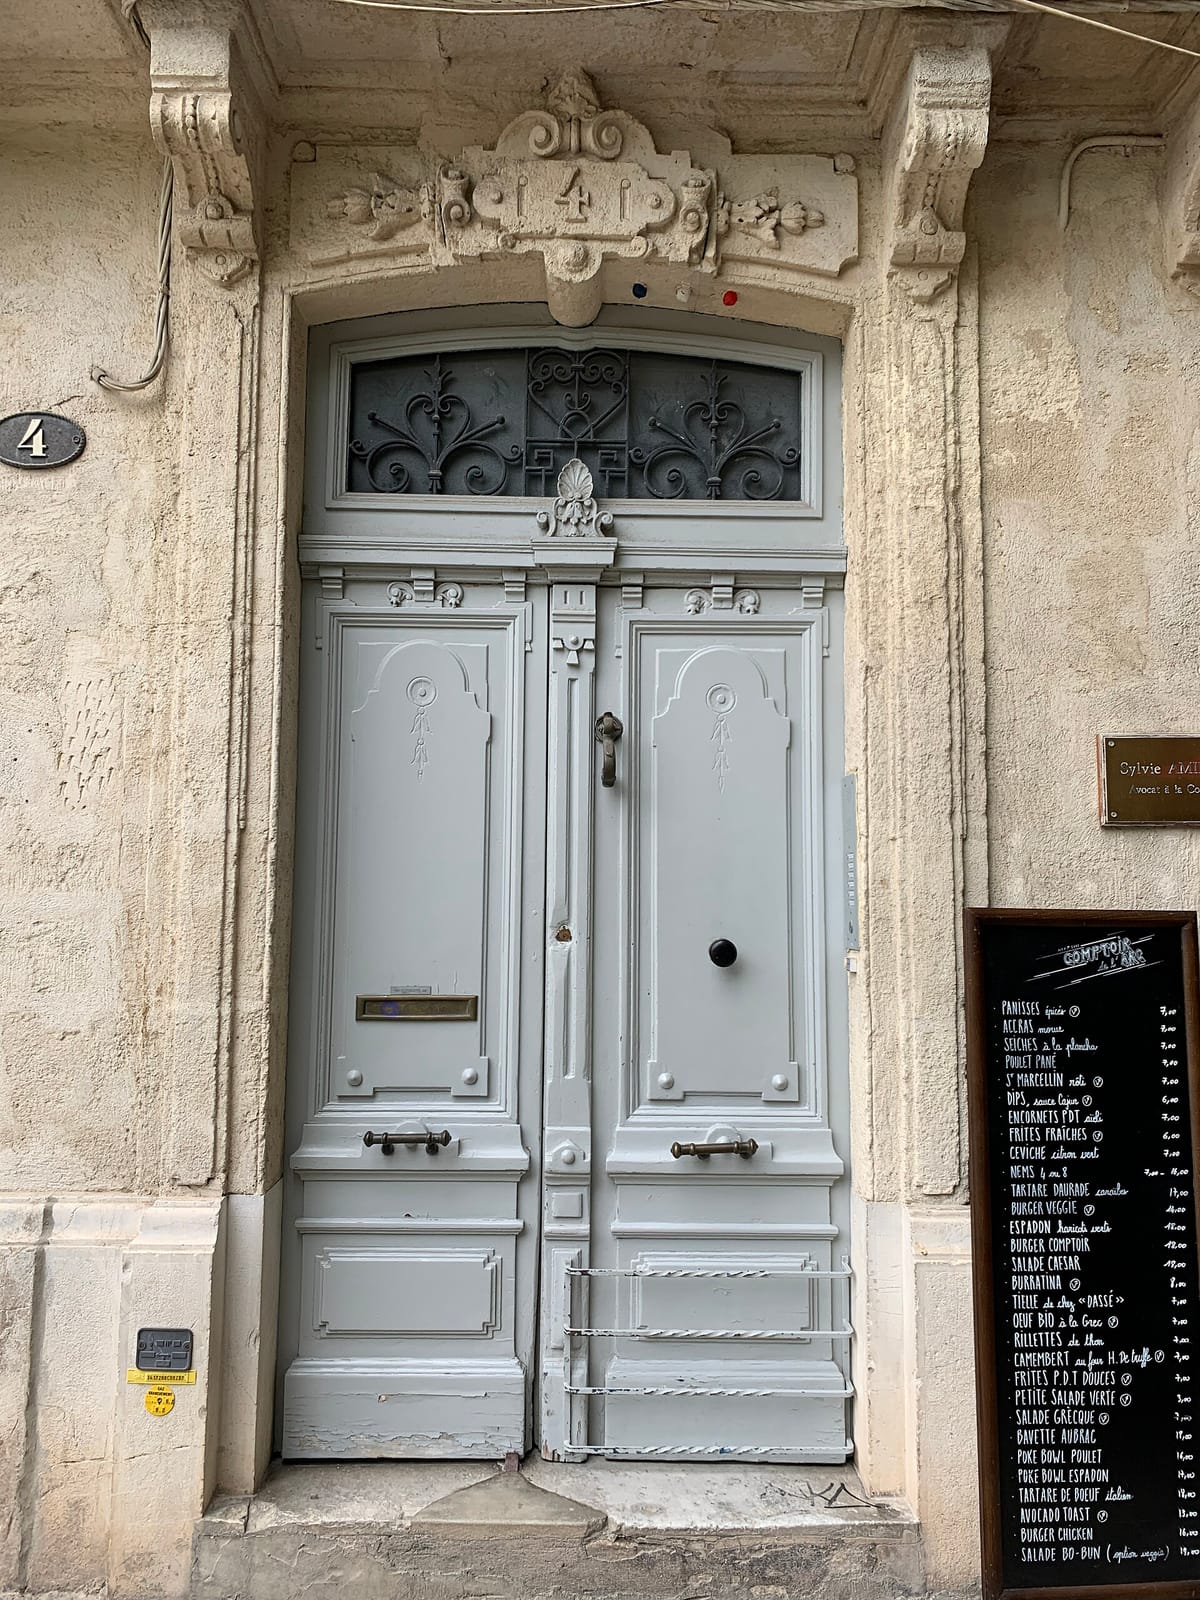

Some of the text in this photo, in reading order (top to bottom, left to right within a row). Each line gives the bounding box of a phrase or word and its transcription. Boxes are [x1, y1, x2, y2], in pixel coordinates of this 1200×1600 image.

[554, 167, 591, 223] 4
[17, 419, 47, 457] 4
[1120, 761, 1161, 776] Sylvie
[1129, 785, 1160, 794] Avocat
[1164, 785, 1170, 794] à
[1174, 784, 1183, 794] la
[1002, 999, 1039, 1015] PANISSES
[1160, 1006, 1176, 1016] 7,00
[1003, 1019, 1033, 1033] ACCRAS
[1004, 1035, 1037, 1051] SEICHES
[1043, 1042, 1050, 1050] à
[1052, 1037, 1062, 1050] la
[1066, 1038, 1098, 1057] plancha
[1006, 1052, 1178, 1068] POULET PANÉ 7,00
[1017, 1070, 1063, 1087] MARCELLIN
[1069, 1074, 1086, 1086] rôti
[1162, 1077, 1178, 1085] 7,00
[1007, 1089, 1029, 1107] DIPS,
[1058, 1093, 1079, 1110] Cajun
[1162, 1096, 1178, 1104] 6,00
[1009, 1110, 1058, 1124] ENCORNETS
[1062, 1110, 1080, 1123] PDT
[1010, 1125, 1180, 1141] FRITES FRAÎCHES 6,00
[1010, 1144, 1045, 1160] CEVICHE
[1051, 1145, 1077, 1159] citron
[1080, 1147, 1099, 1159] vert
[1011, 1165, 1034, 1178] NEMS
[1041, 1168, 1045, 1179] 4
[1062, 1167, 1067, 1177] 8
[1011, 1184, 1048, 1197] TARTARE
[1054, 1183, 1089, 1196] DAURADE
[1012, 1201, 1043, 1215] BURGER
[1046, 1198, 1077, 1214] VEGGIE
[1010, 1220, 1050, 1234] ESPADON
[1057, 1220, 1087, 1233] haricots
[1090, 1221, 1112, 1232] verts
[1011, 1238, 1044, 1252] BURGER
[1049, 1235, 1090, 1252] COMPTOIR
[1012, 1257, 1044, 1272] SALADE
[1048, 1255, 1080, 1271] CAESAR
[1012, 1272, 1061, 1290] BURRATINA
[1012, 1292, 1038, 1309] TIELLE
[1043, 1297, 1054, 1308] de
[1057, 1296, 1075, 1312] chez
[1013, 1313, 1033, 1328] OEUF
[1038, 1310, 1054, 1327] BIO
[1058, 1318, 1067, 1328] à
[1069, 1315, 1078, 1327] la
[1082, 1314, 1102, 1327] Grec
[1015, 1330, 1062, 1347] RILLETTES
[1068, 1334, 1080, 1346] de
[1084, 1333, 1104, 1346] thon
[1015, 1351, 1069, 1367] CAMEMBERT
[1088, 1351, 1103, 1371] four
[1131, 1347, 1152, 1368] truffe
[1015, 1368, 1048, 1386] FRITES
[1054, 1370, 1077, 1385] P.D.T
[1083, 1370, 1115, 1385] DOUCES
[1016, 1387, 1046, 1405] PETITE
[1051, 1390, 1085, 1406] SALADE
[1090, 1390, 1115, 1405] VERTE
[1016, 1409, 1049, 1425] SALADE
[1054, 1407, 1094, 1424] GRÈCQUE
[1017, 1429, 1055, 1445] BAVETTE
[1062, 1429, 1096, 1444] AUBRAC
[1018, 1449, 1037, 1464] POKE
[1041, 1449, 1065, 1464] BOWL
[1071, 1449, 1101, 1463] POULET
[1018, 1469, 1038, 1483] POKE
[1042, 1469, 1066, 1483] BOWL
[1069, 1469, 1108, 1482] ESPADON
[1019, 1488, 1057, 1503] TARTARE
[1061, 1488, 1070, 1502] DE
[1075, 1488, 1100, 1502] BOEUF
[1105, 1486, 1133, 1501] italien
[1021, 1508, 1060, 1523] AVOCADO
[1063, 1507, 1090, 1521] TOAST
[1021, 1528, 1054, 1542] BURGER
[1058, 1525, 1092, 1541] CHICKEN
[1022, 1548, 1055, 1561] SALADE
[1063, 1546, 1100, 1561] BO-BUN
